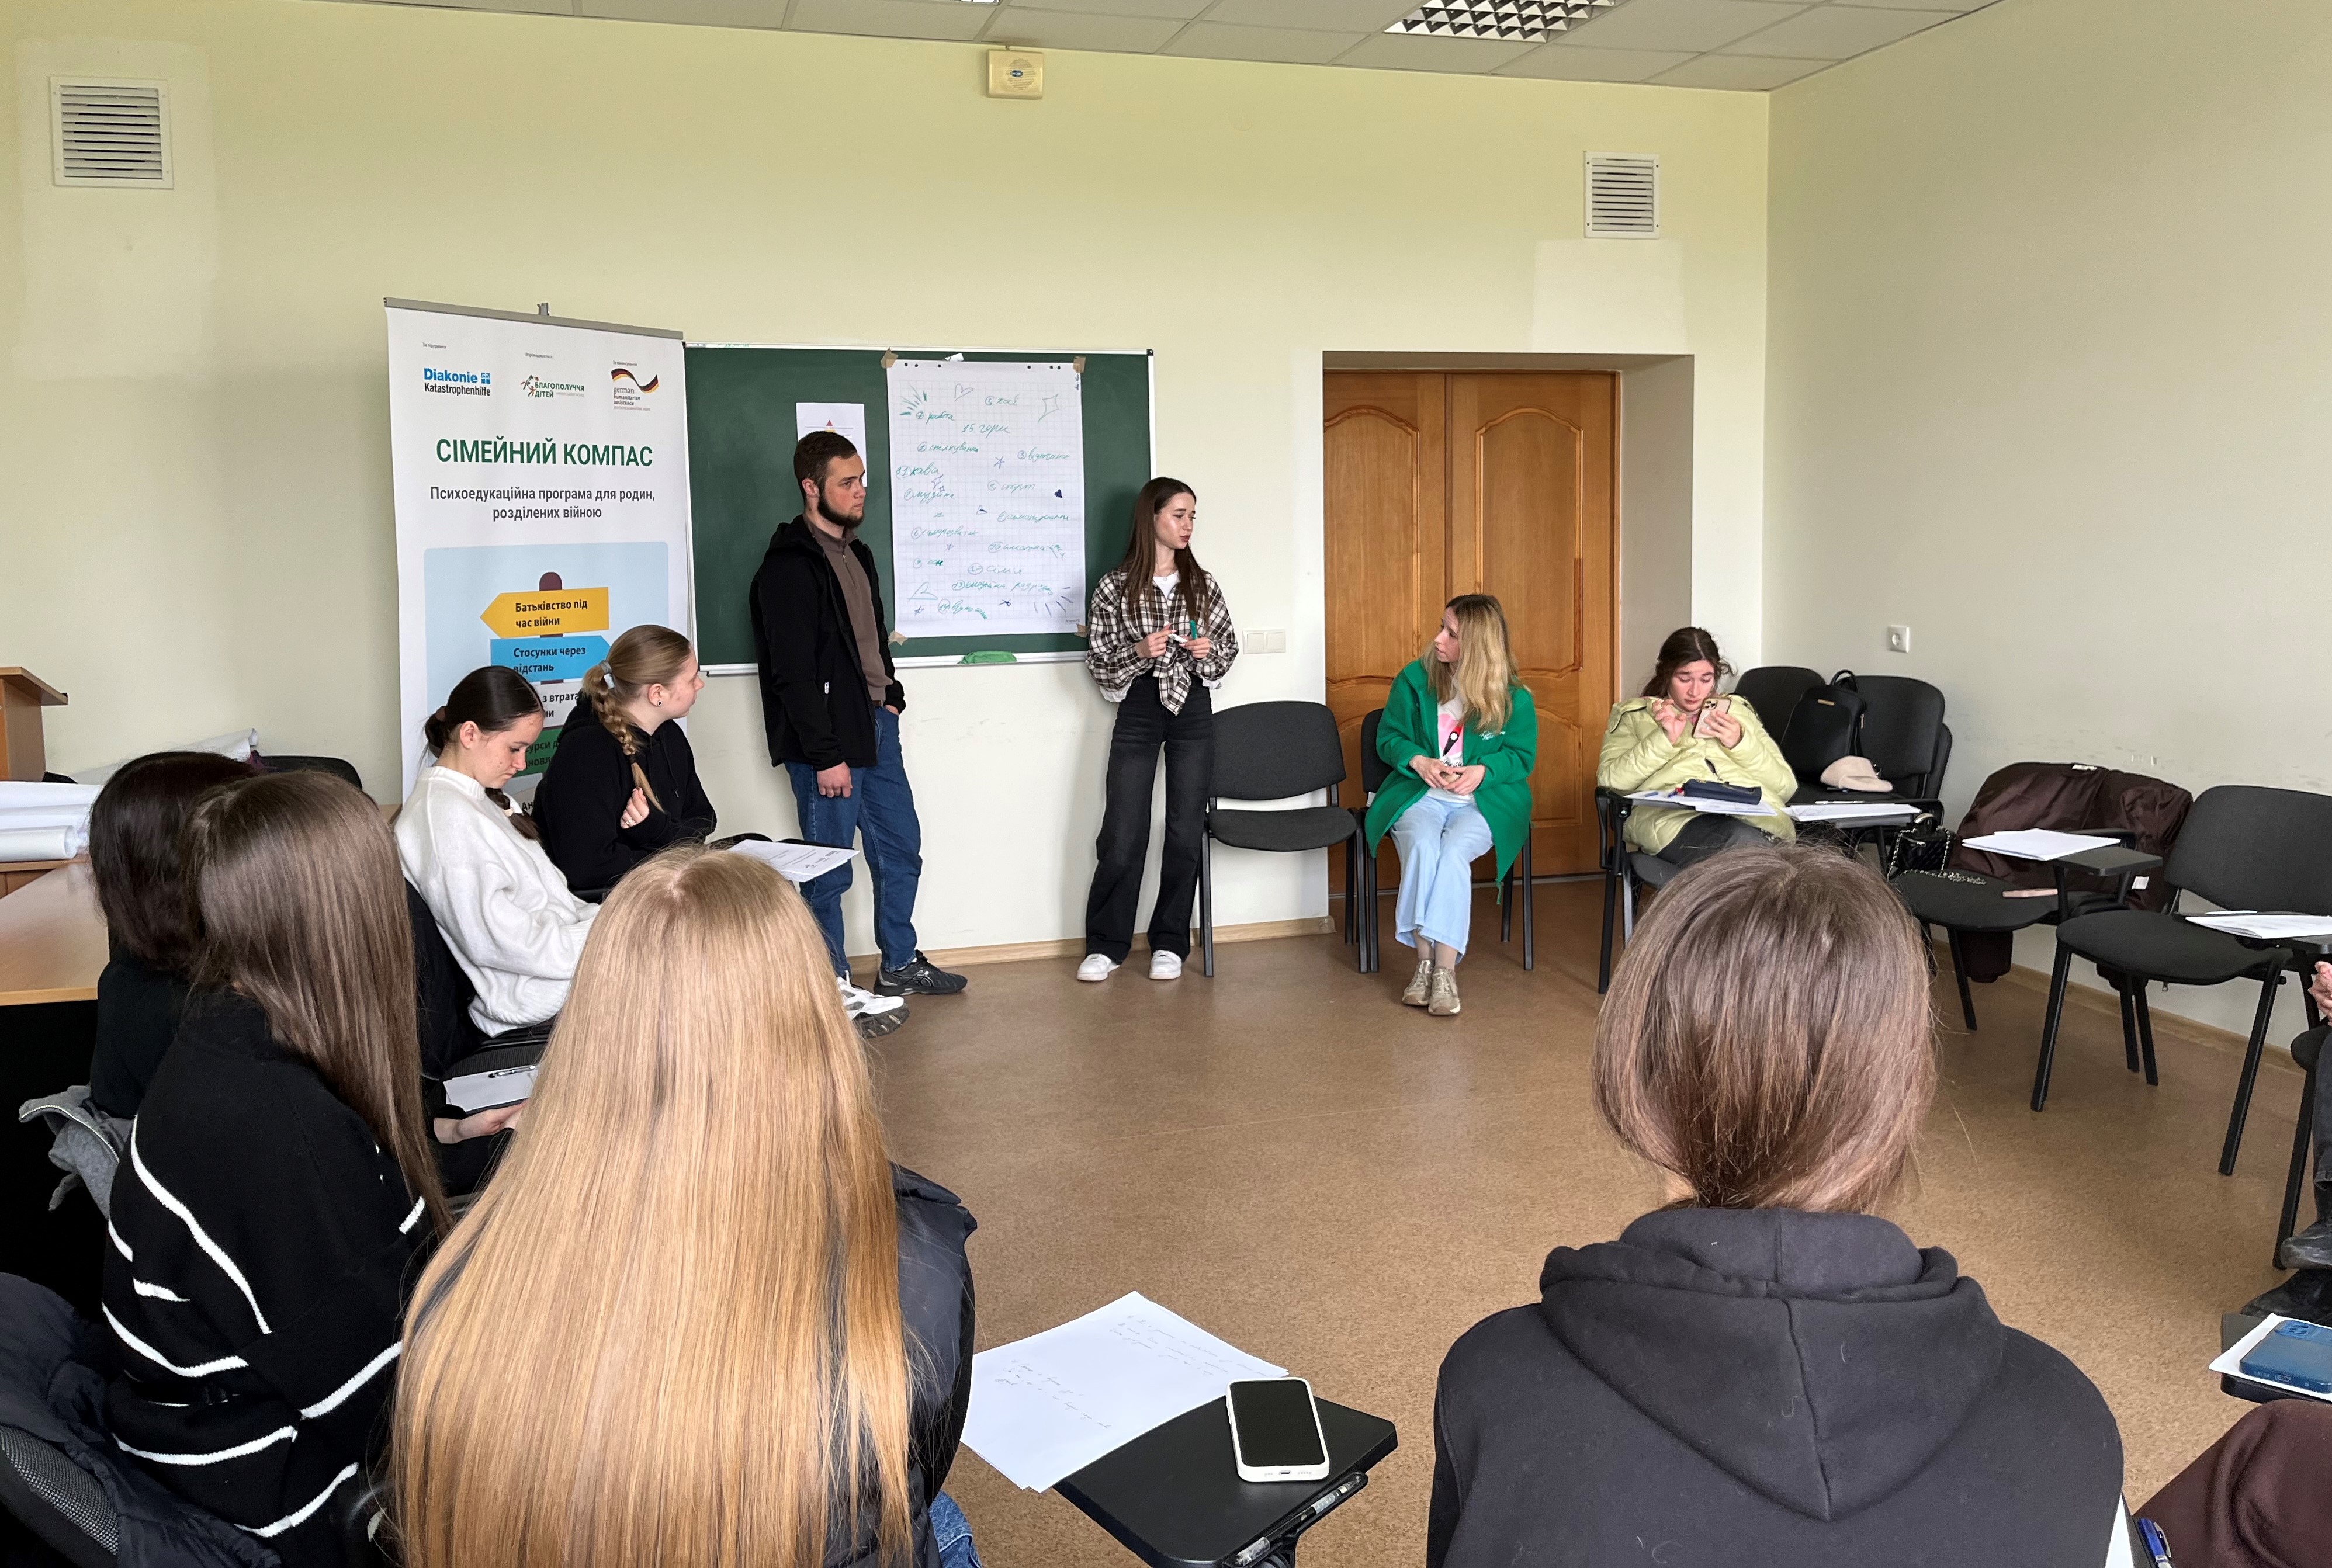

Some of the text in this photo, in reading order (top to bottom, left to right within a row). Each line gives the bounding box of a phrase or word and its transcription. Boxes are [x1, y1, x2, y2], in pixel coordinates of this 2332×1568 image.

[424, 368, 478, 383] Diakonie
[424, 383, 491, 396] Katastrophenhilfe
[535, 381, 584, 391] БЛАГОПОЛУЧЧЯ
[961, 423, 975, 433] 15
[436, 436, 653, 467] СІМЕЙНИЙ КОМПАС
[910, 462, 940, 476] кава
[431, 487, 655, 502] Психоедукаційна програма для родин,
[493, 505, 602, 522] розділених війною
[515, 599, 588, 612] Батьківство під
[516, 616, 560, 628] час війни
[513, 647, 586, 659] Стосунки через
[514, 664, 554, 674] відстань
[549, 693, 578, 703] втрата
